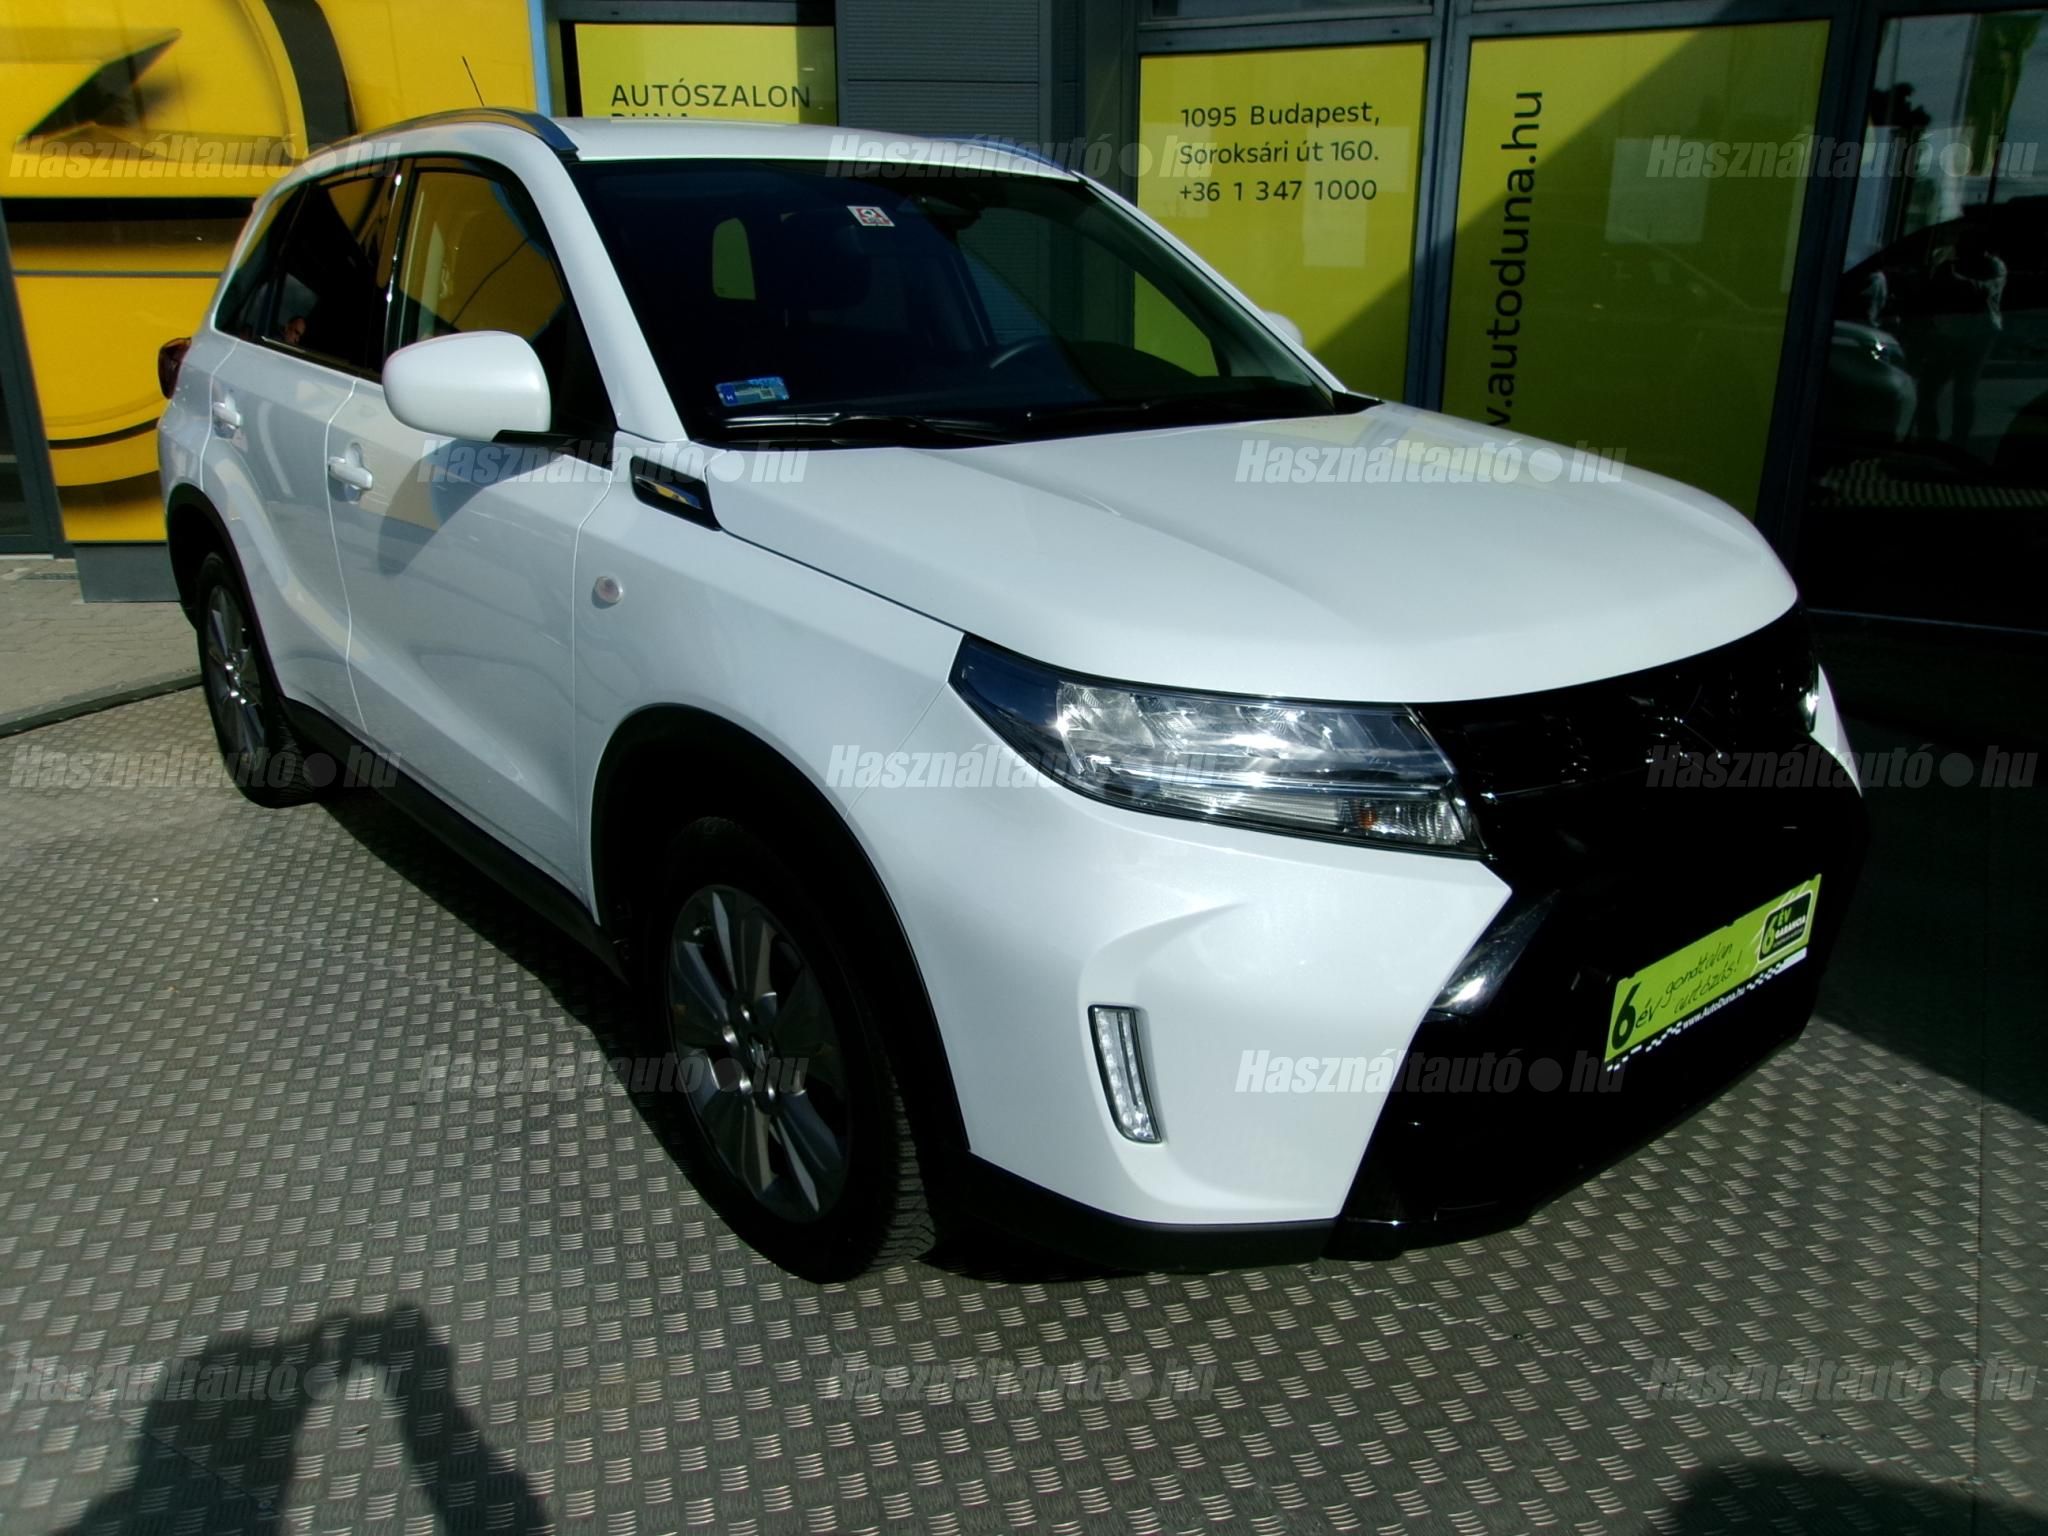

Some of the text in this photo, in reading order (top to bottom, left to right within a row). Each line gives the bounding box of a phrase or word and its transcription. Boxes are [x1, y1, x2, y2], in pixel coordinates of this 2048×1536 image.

[610, 78, 811, 108] AUTÓSZALON
[1180, 101, 1380, 128] 1095 Budapest,
[1180, 140, 1380, 165] Soroksári út 160.
[1179, 179, 1378, 202] +36 1 347 1000
[1761, 915, 1778, 955] 6
[1611, 981, 1642, 1051] 6
[1635, 994, 1663, 1029] év
